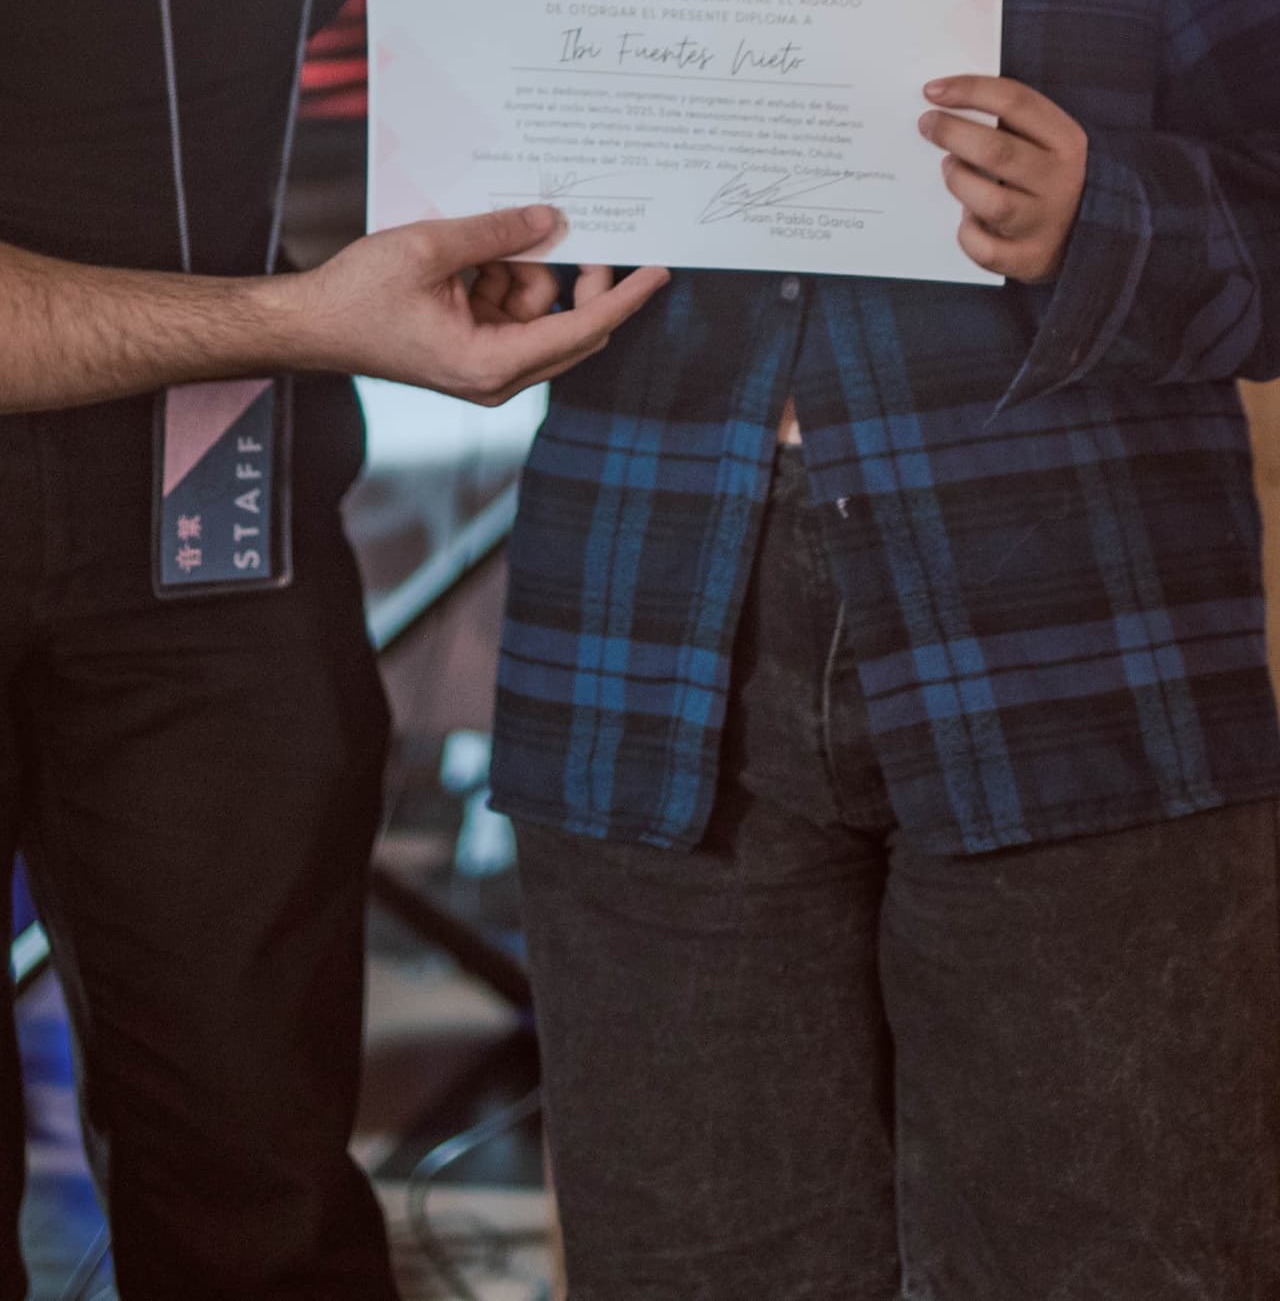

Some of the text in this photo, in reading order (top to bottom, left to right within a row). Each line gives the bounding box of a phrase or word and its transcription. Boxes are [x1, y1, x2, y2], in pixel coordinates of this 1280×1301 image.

[545, 2, 814, 26] DE OTORGAR EL PRESENTE DIPLOMA A
[559, 26, 806, 77] Ibi Fuentes Nieto
[776, 211, 814, 227] Pablo
[770, 225, 832, 241] PROFESOR
[233, 435, 263, 571] STAFF
